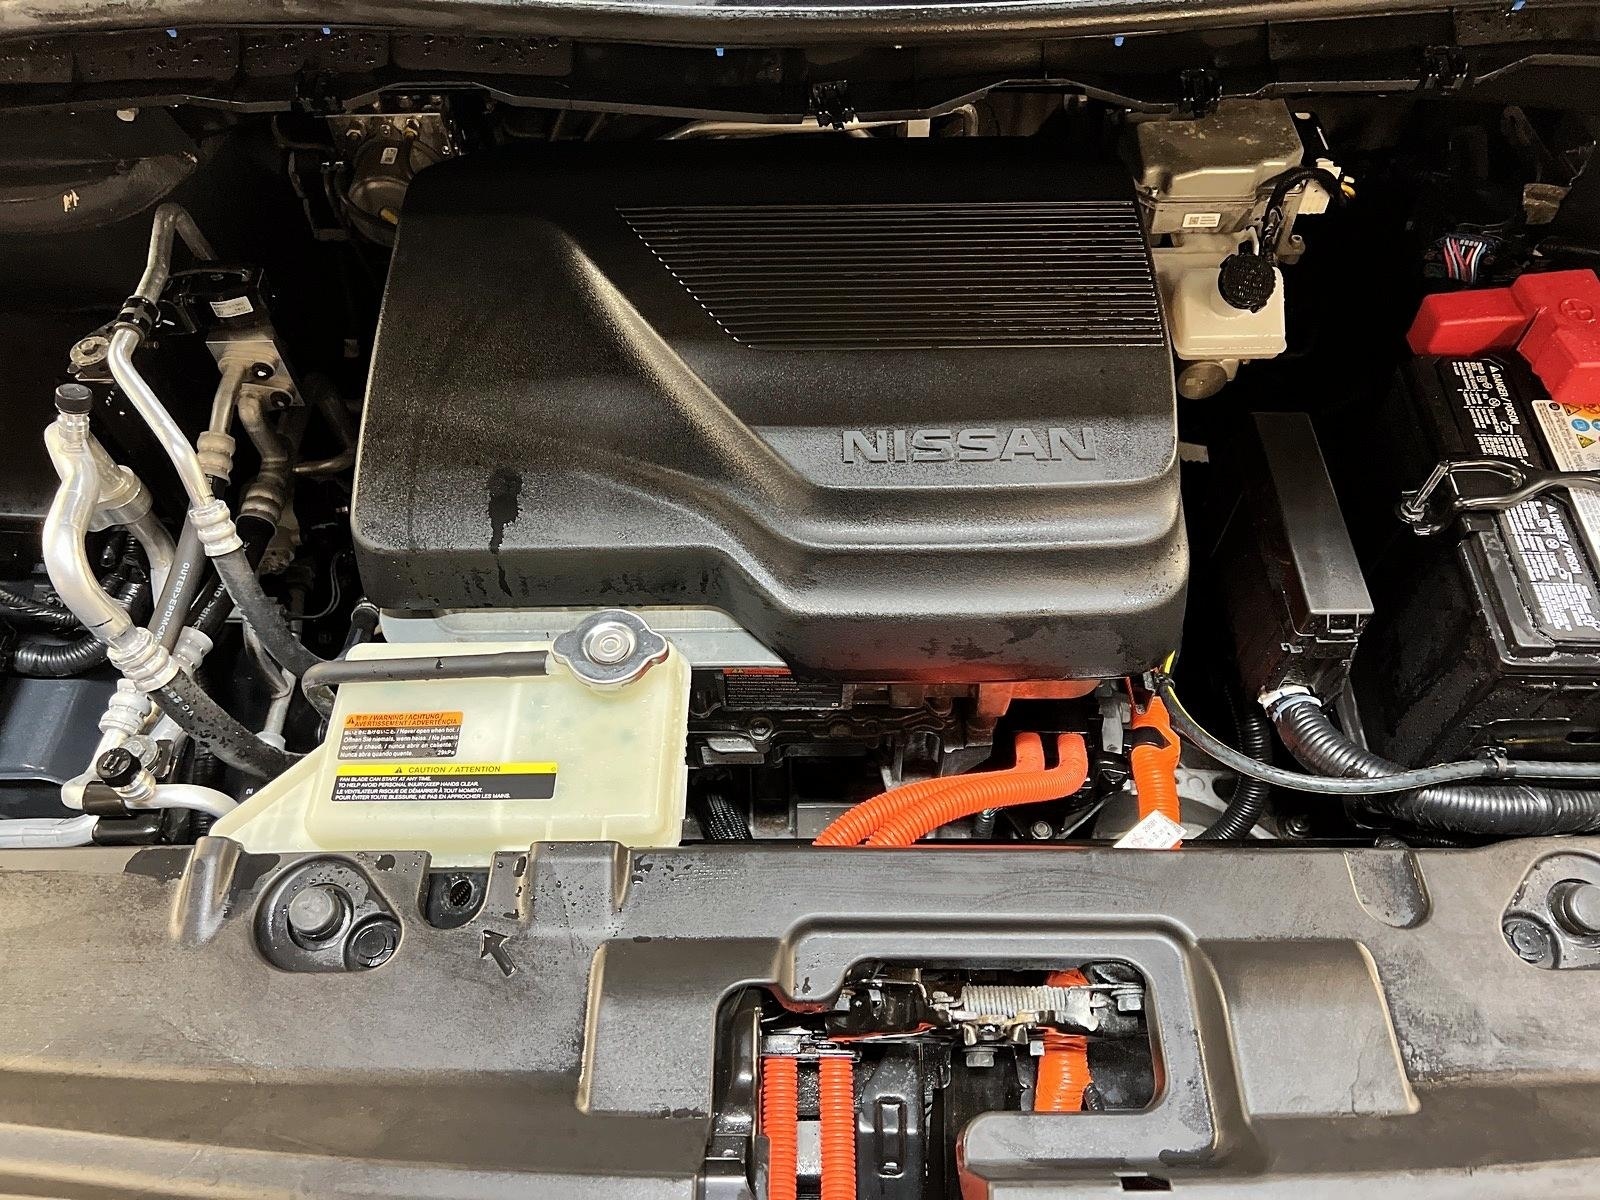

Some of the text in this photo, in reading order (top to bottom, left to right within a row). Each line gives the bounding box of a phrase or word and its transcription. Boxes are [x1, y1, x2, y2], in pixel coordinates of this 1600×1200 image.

[842, 427, 1097, 463] NISSAN
[408, 766, 447, 774] CAUTION
[455, 765, 501, 773] ATTENTION
